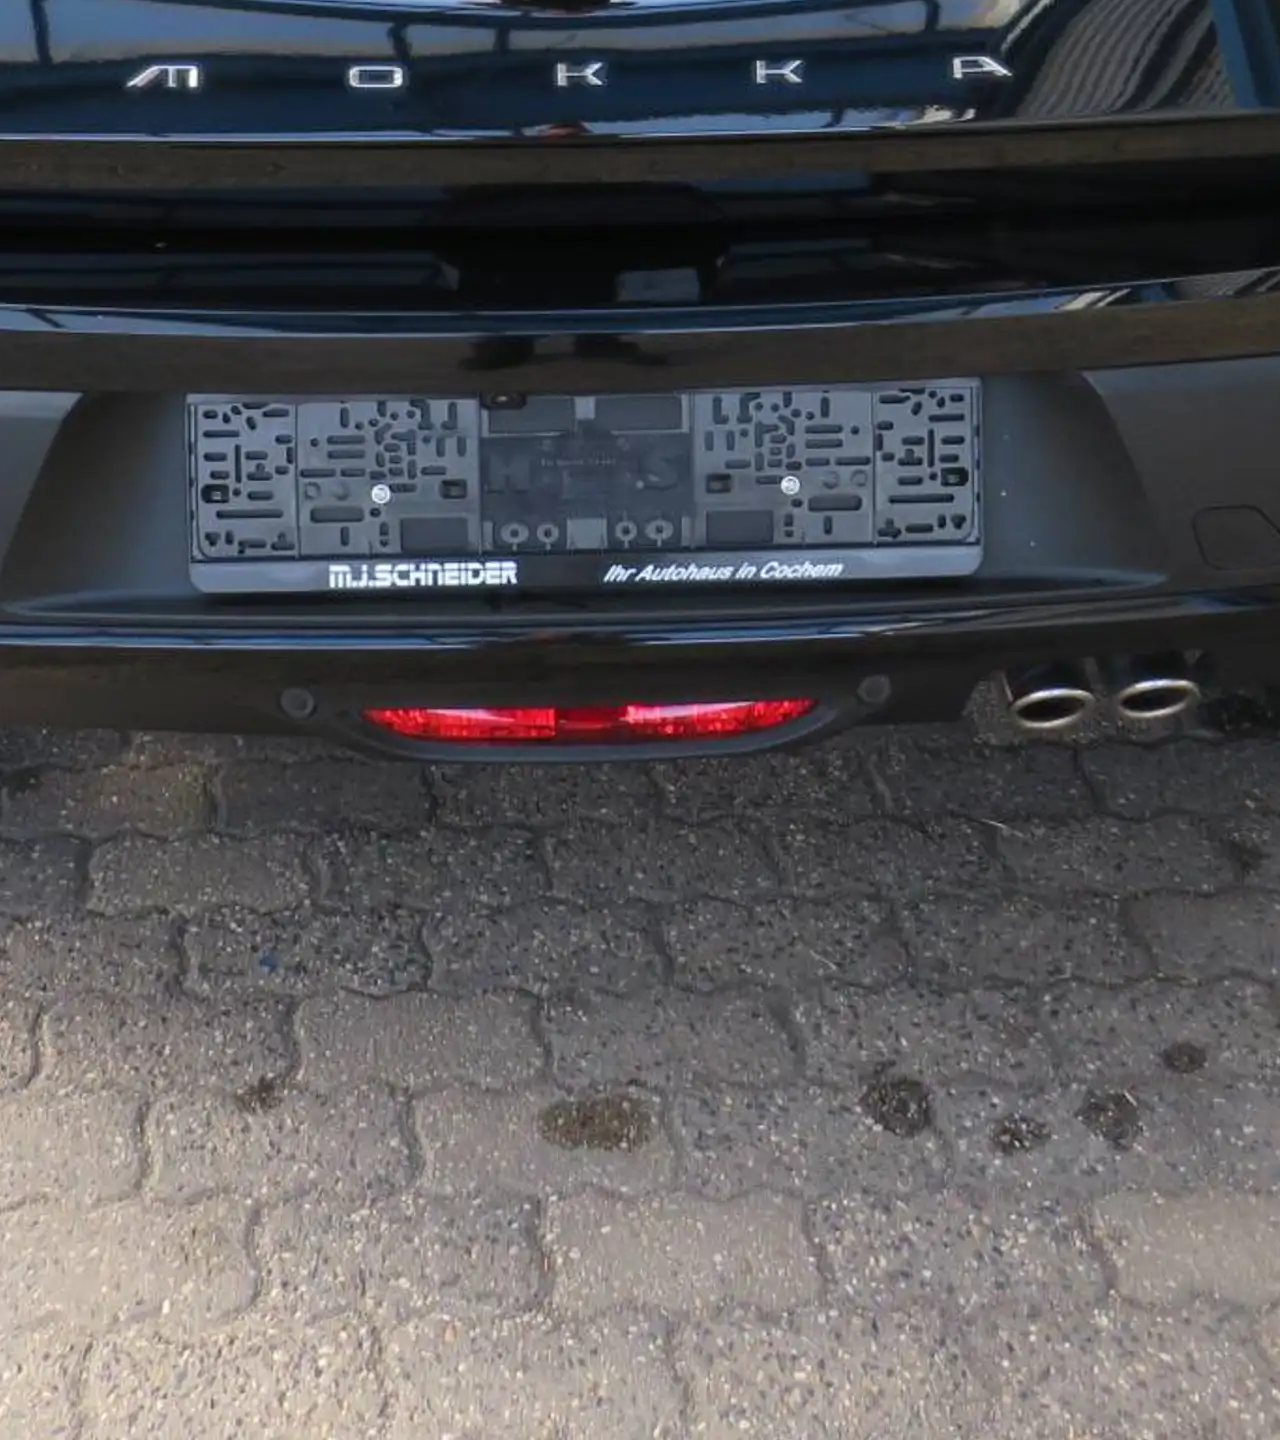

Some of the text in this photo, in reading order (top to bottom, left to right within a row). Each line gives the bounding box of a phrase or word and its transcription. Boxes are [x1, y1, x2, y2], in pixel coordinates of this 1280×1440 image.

[603, 560, 845, 583] Ihr Autohaus in Cochem
